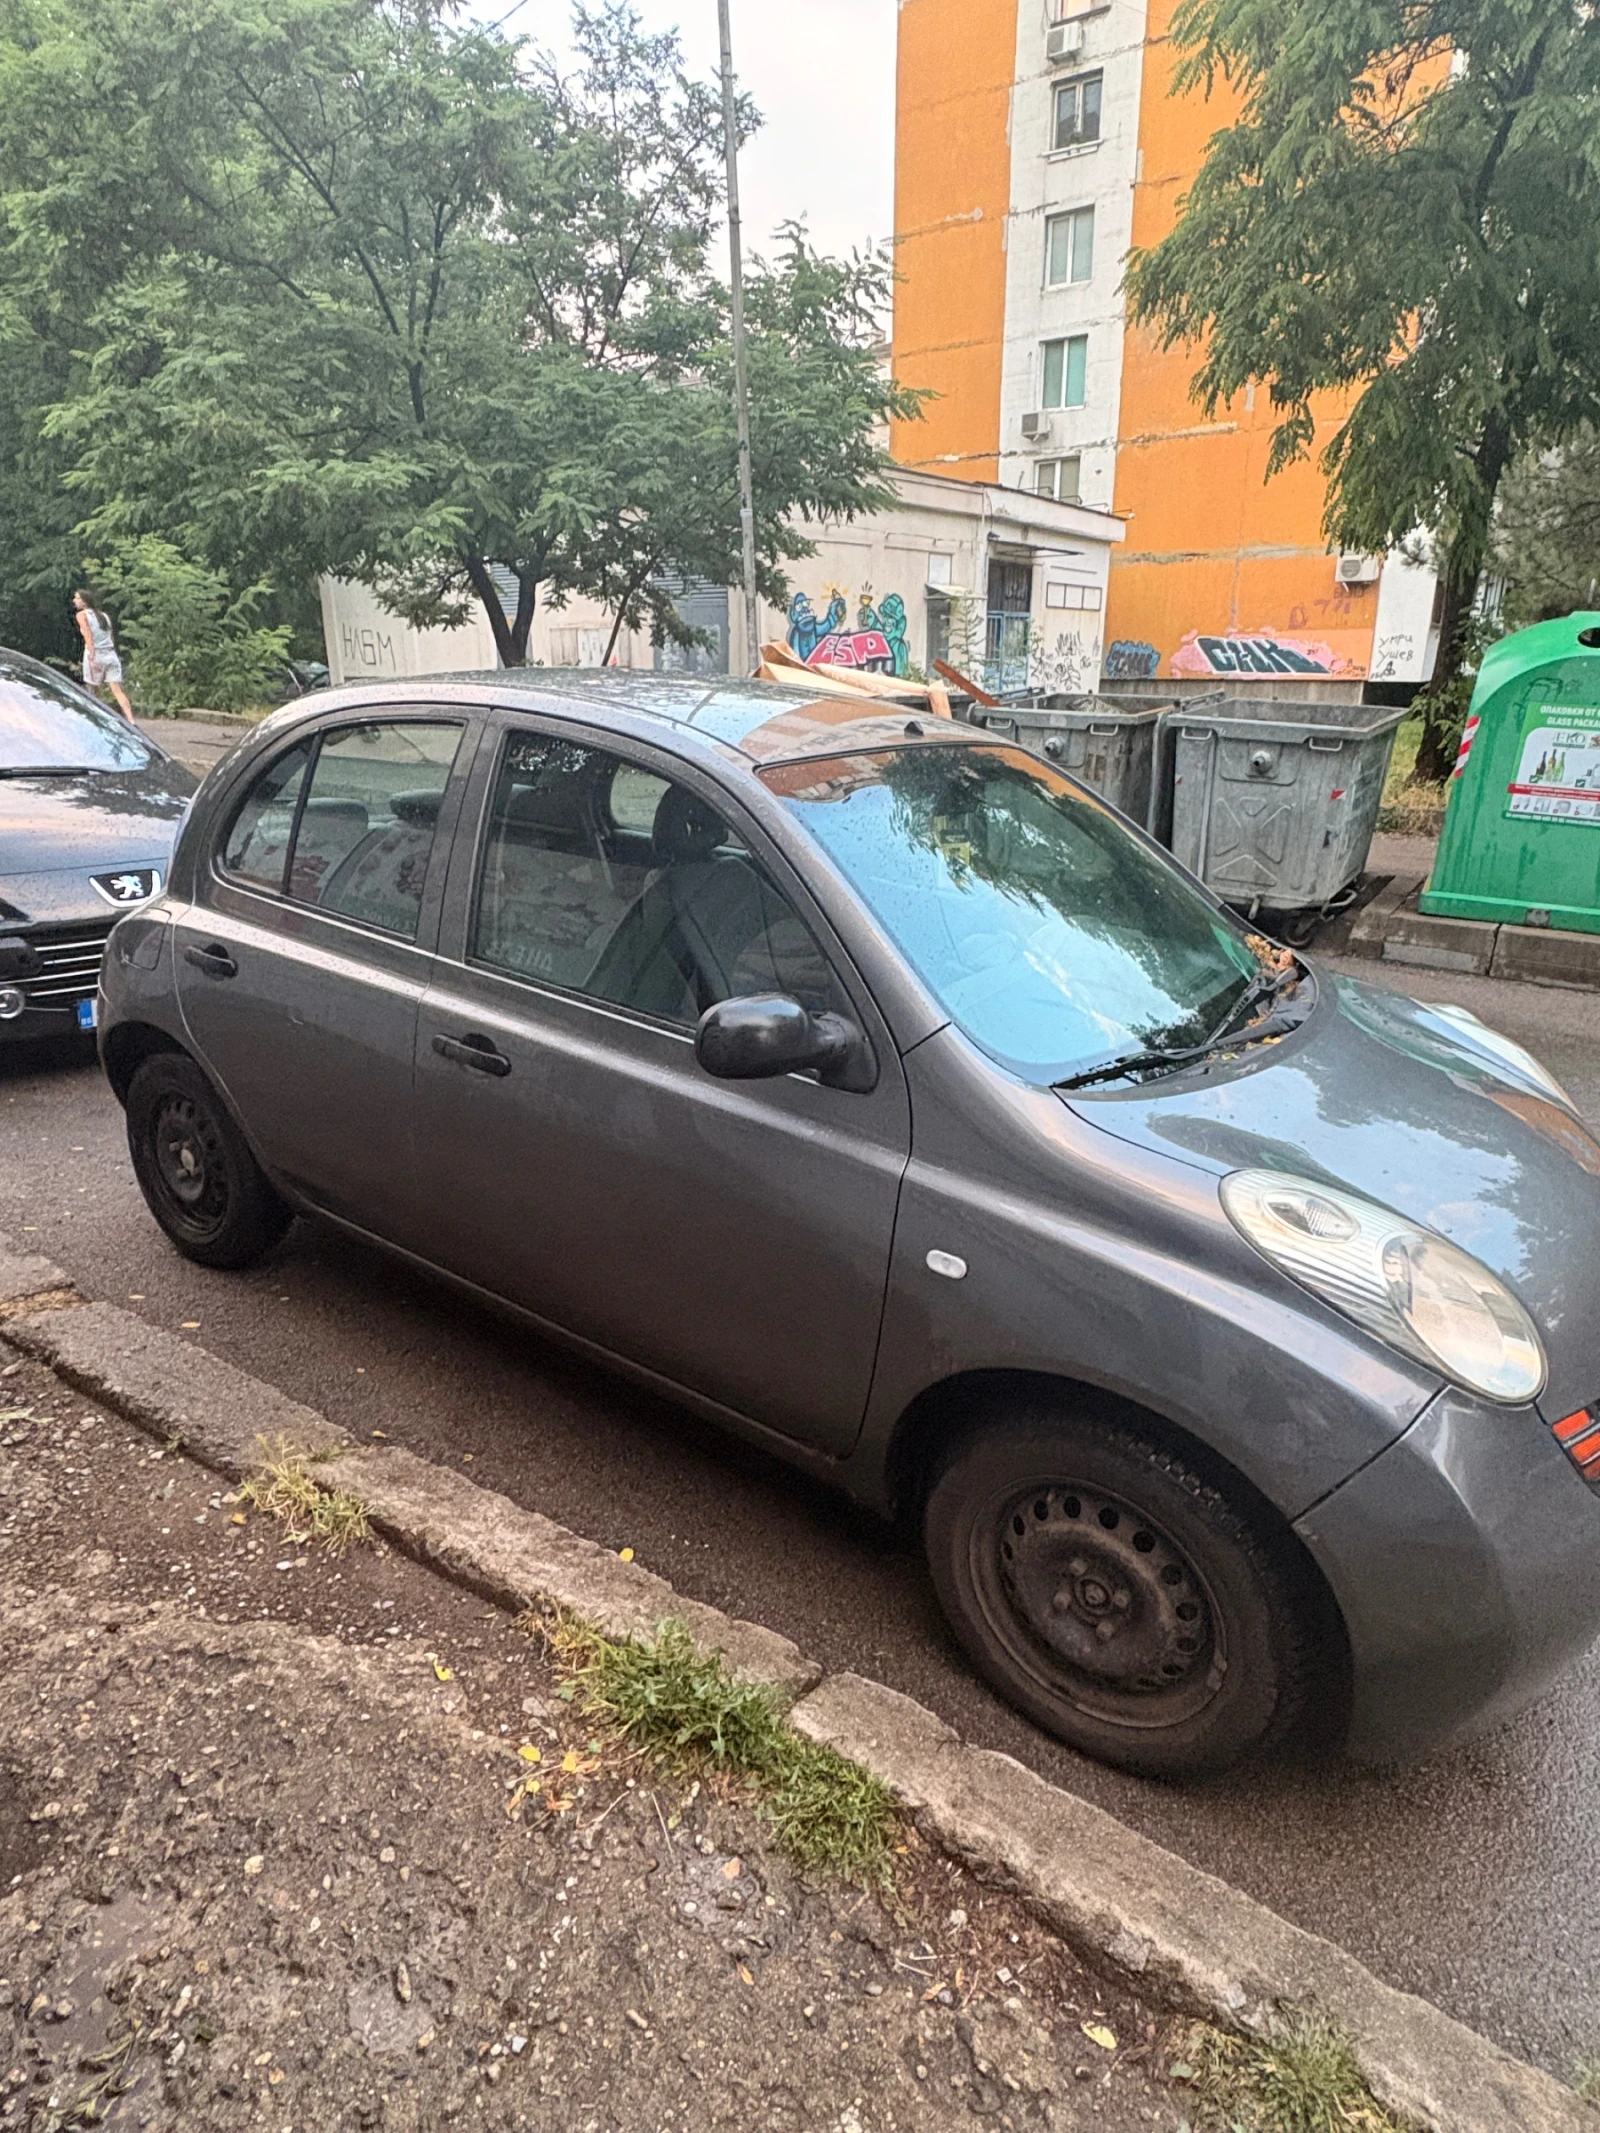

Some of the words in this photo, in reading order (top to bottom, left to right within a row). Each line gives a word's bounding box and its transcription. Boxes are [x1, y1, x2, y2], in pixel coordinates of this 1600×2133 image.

[1540, 705, 1584, 715] ОПАКОВКИ
[1585, 708, 1597, 717] ОТ
[1547, 716, 1572, 726] GLASS
